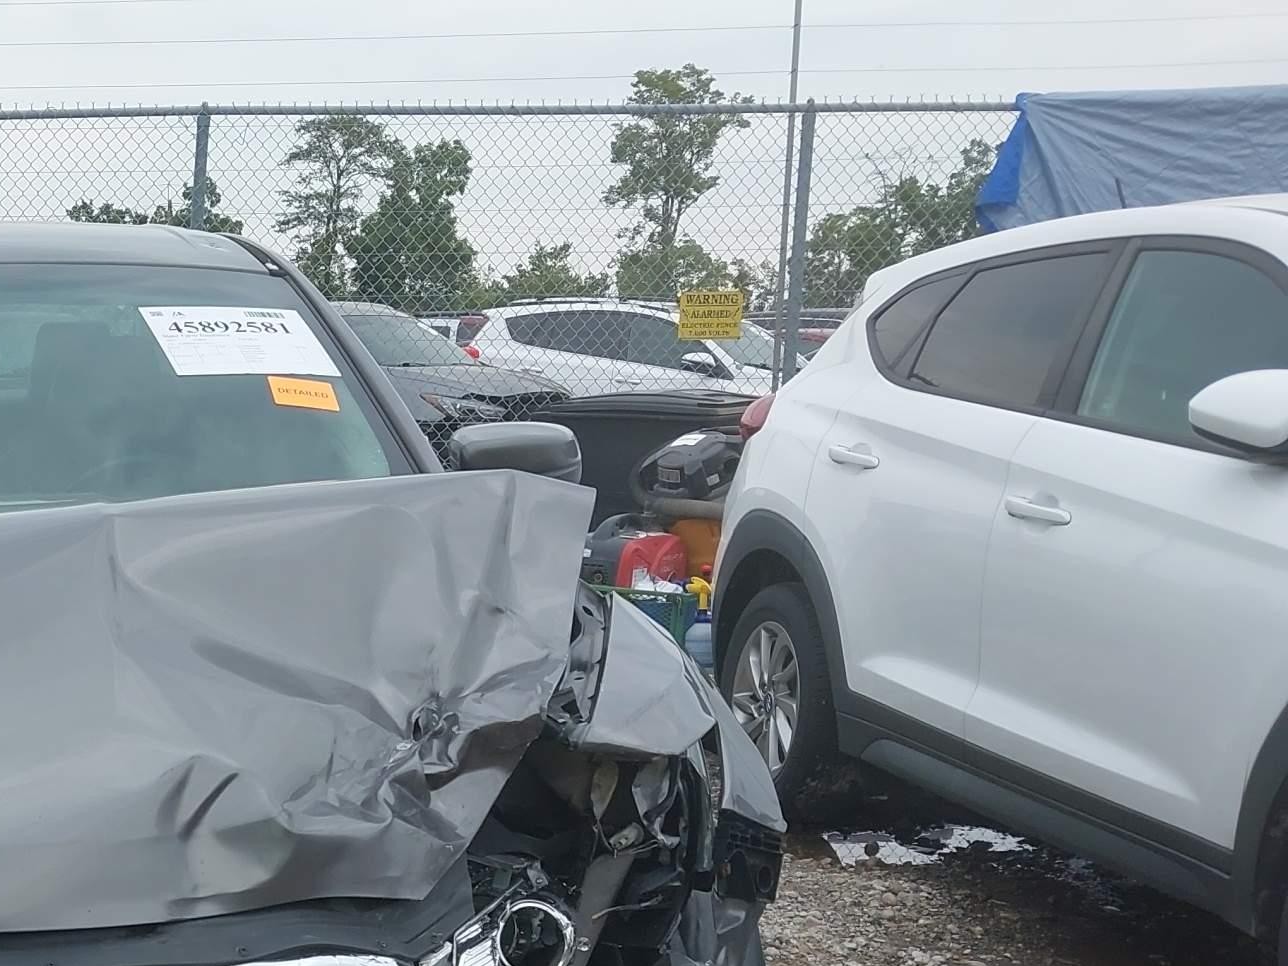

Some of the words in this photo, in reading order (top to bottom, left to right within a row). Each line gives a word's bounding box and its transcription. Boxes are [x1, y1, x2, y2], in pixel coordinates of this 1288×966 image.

[686, 294, 739, 305] WARNING
[168, 320, 293, 335] 45892581
[277, 387, 329, 400] DETAILED
